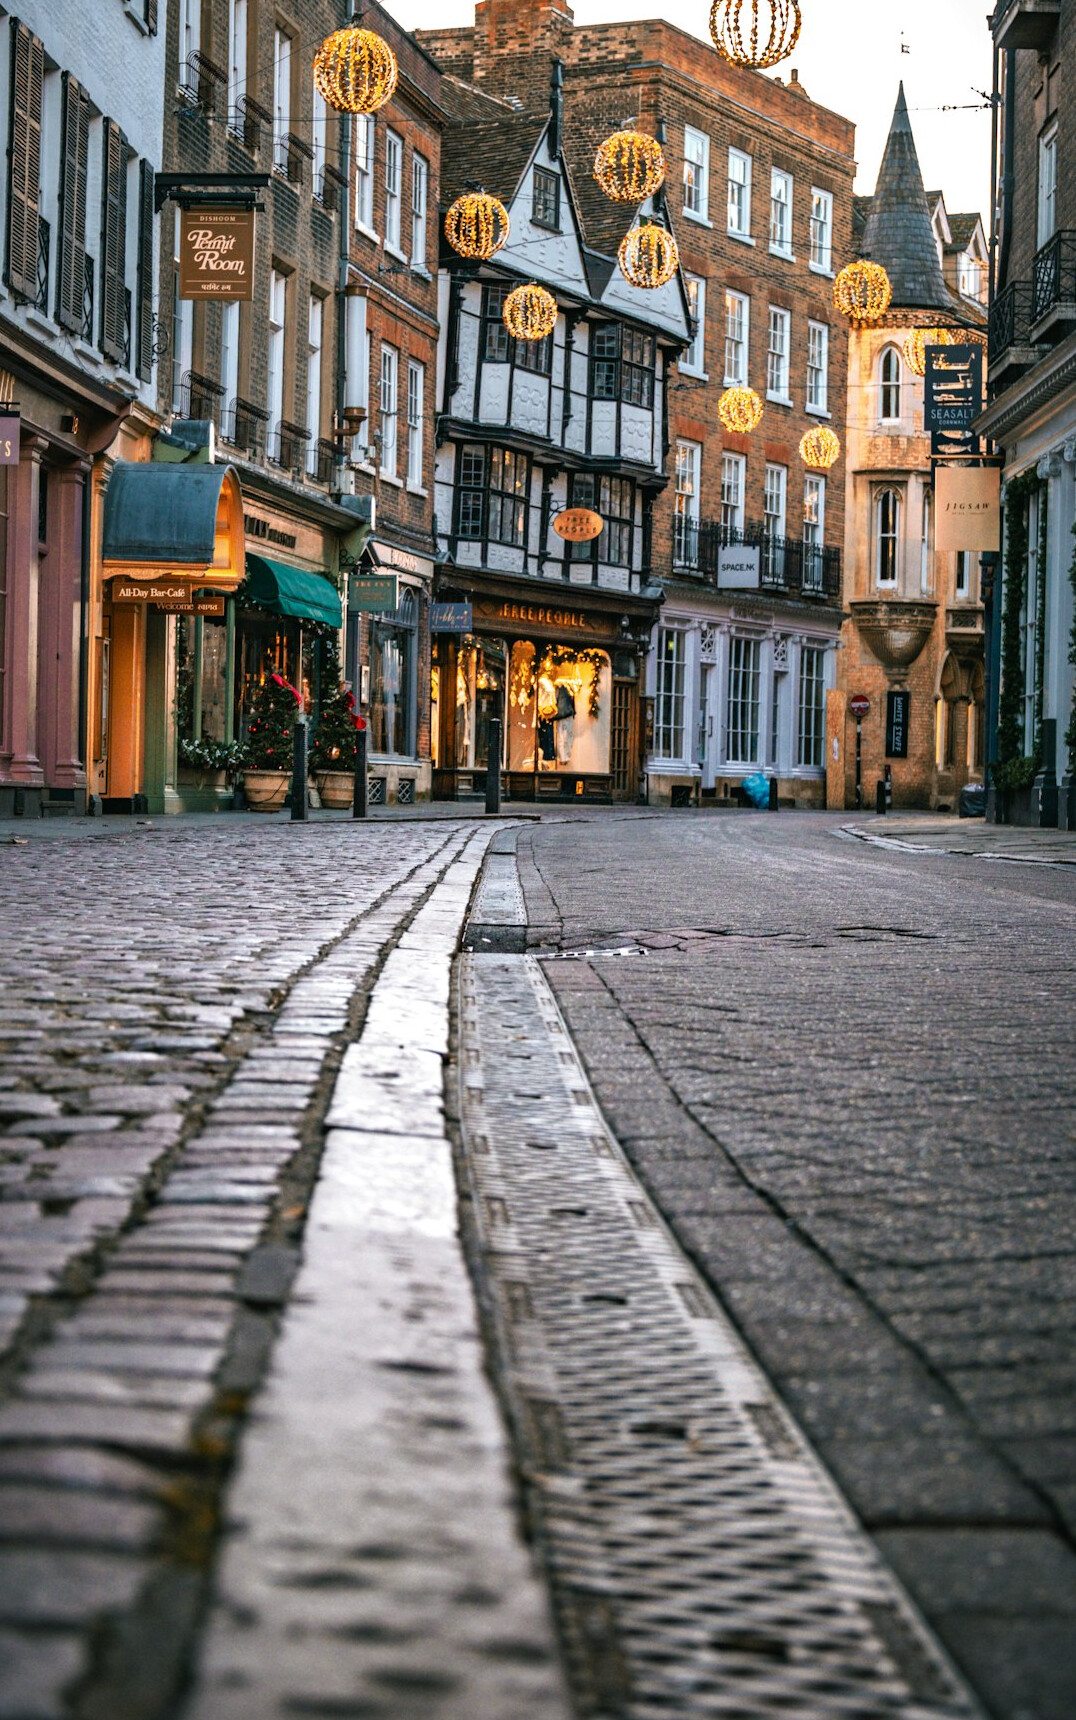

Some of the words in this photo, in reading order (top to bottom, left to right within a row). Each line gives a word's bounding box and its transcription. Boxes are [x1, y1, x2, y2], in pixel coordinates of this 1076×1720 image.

[187, 229, 236, 254] Permit
[194, 250, 245, 275] Room
[930, 408, 976, 420] SEASALT
[945, 502, 990, 512] JIGSAW
[566, 516, 590, 525] FREE
[558, 525, 597, 534] PEOPLE
[118, 587, 149, 598] All-Day
[150, 587, 186, 598] Bar-Café
[156, 602, 194, 611] Welcome
[503, 603, 535, 621] FREE
[538, 608, 586, 627] PEOPLE
[895, 725, 903, 752] STUFF
